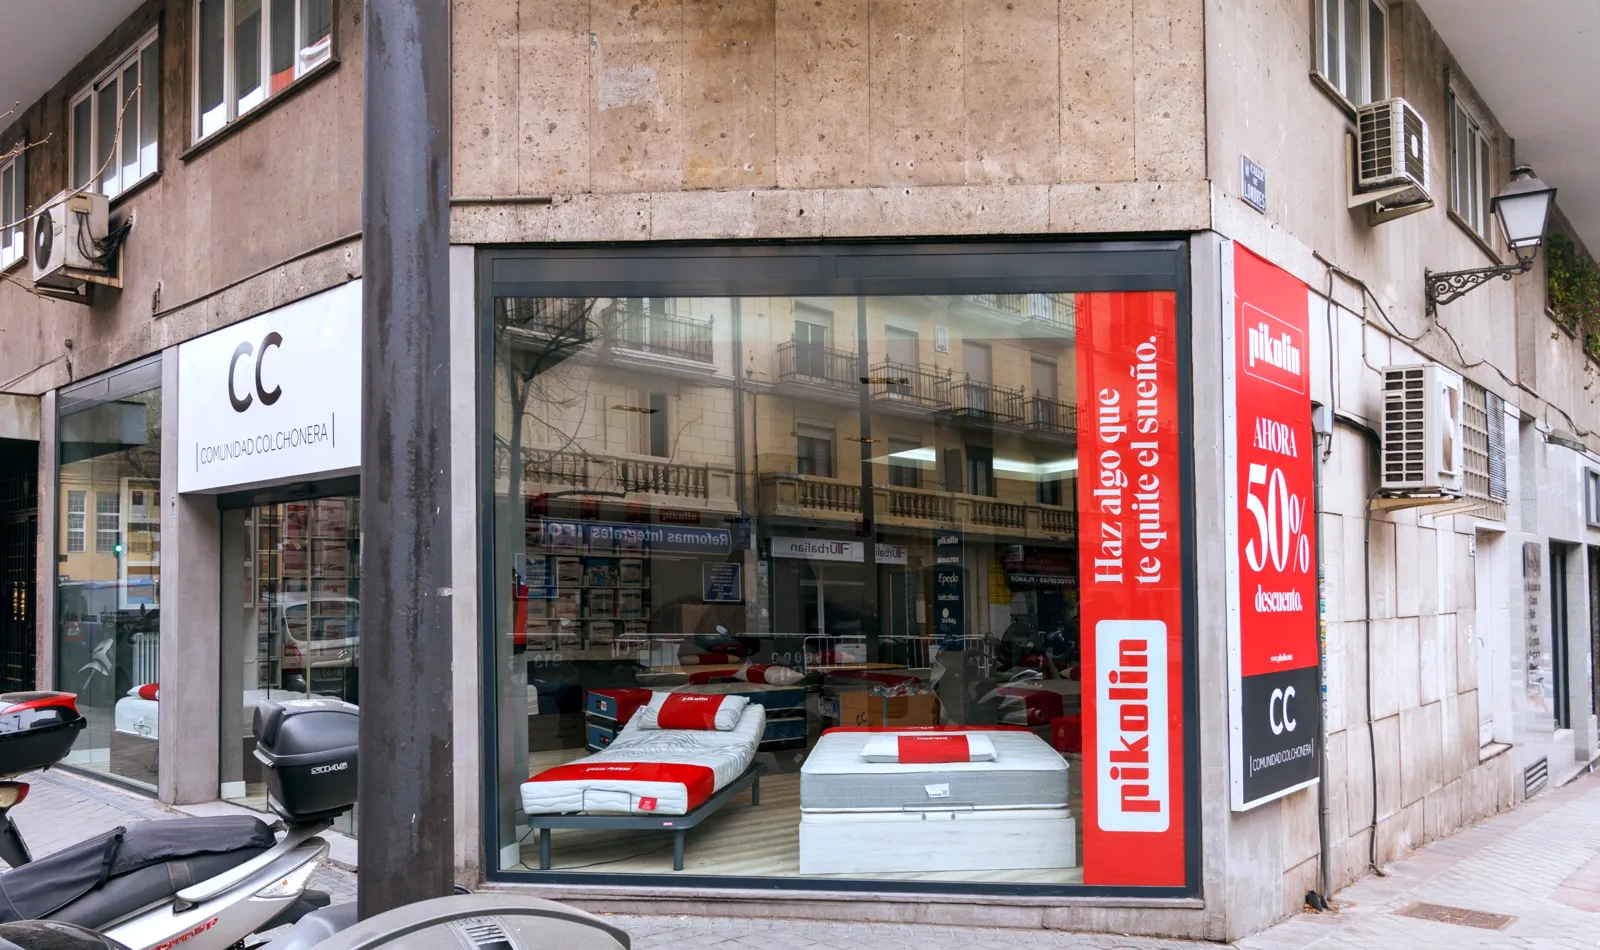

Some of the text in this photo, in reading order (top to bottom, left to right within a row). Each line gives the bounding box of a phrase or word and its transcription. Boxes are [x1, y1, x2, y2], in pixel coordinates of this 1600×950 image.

[228, 331, 283, 413] CC
[1249, 322, 1300, 376] pikolin
[200, 423, 329, 465] COMUNIDAD COLCHONERA
[1130, 335, 1167, 584] te quite el sueño.
[1253, 416, 1297, 458] AHORA
[1093, 388, 1128, 584] Haz algo que
[1245, 463, 1310, 574] 50%
[938, 572, 959, 586] Epeda
[1255, 584, 1303, 612] descuento.
[1108, 639, 1161, 812] pikolin
[1269, 686, 1296, 735] CC
[1252, 743, 1312, 772] COMUNIDAD COLCHONERA
